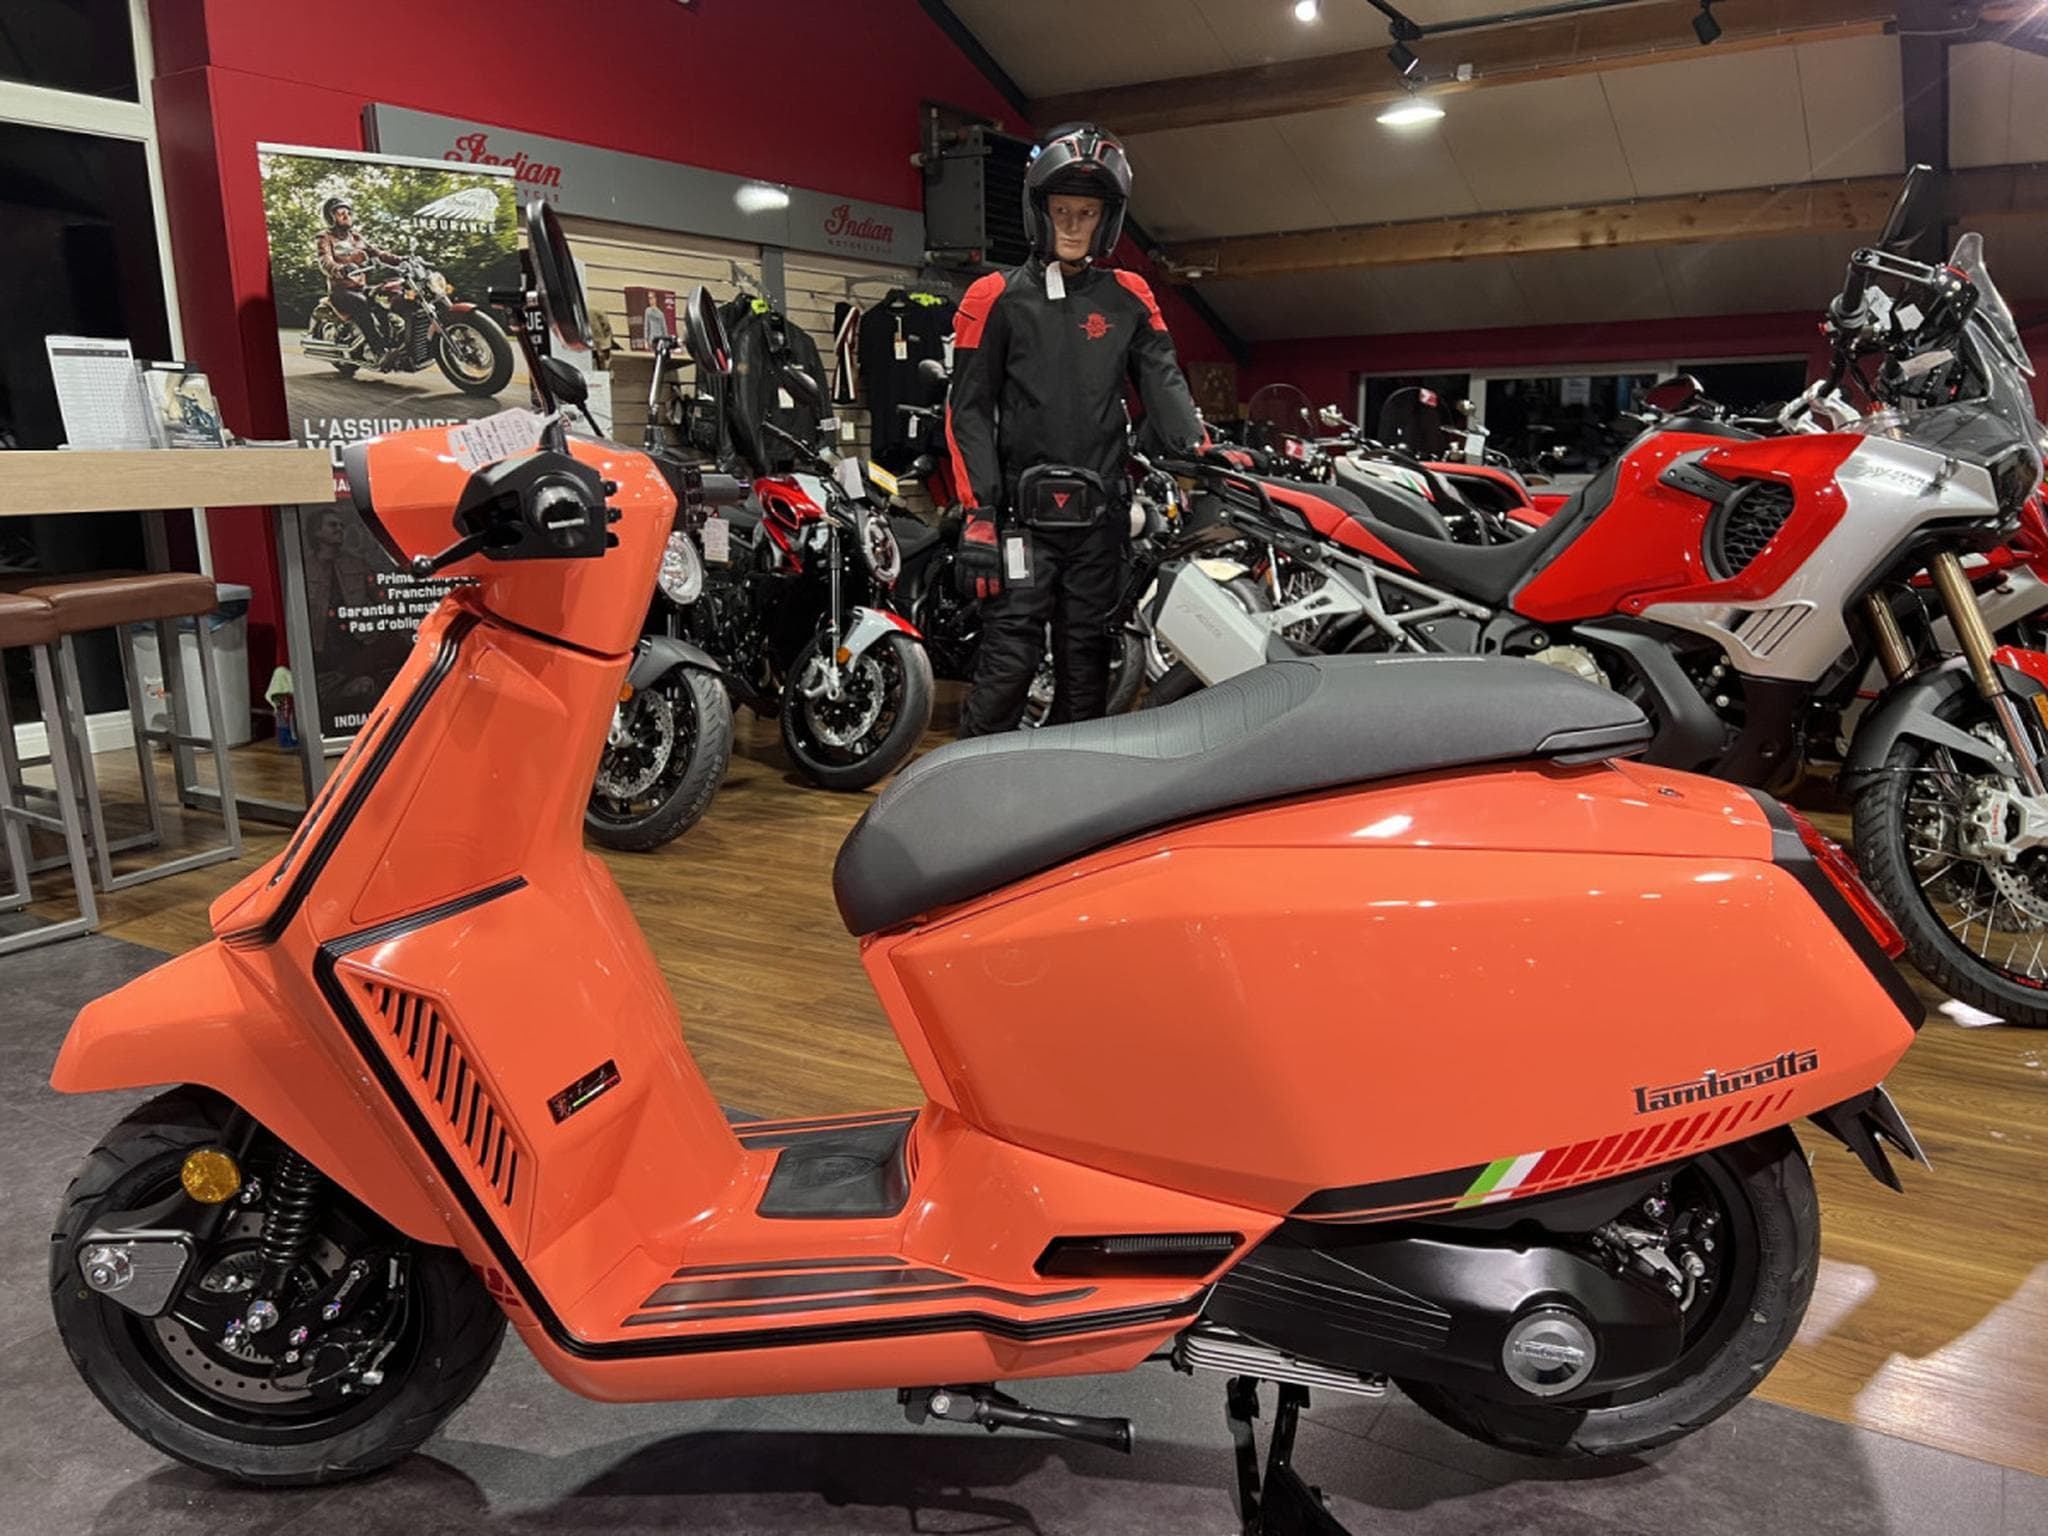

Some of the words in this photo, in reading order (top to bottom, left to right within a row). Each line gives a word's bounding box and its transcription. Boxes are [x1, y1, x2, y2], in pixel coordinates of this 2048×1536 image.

[413, 217, 497, 234] INSURANCE
[824, 204, 894, 242] Indian
[376, 573, 415, 585] Prime
[338, 604, 394, 618] Garantie
[350, 620, 374, 632] Pas
[377, 617, 420, 631] d'oblig
[334, 713, 368, 728] INDIA
[1633, 1049, 1819, 1116] Lambretta
